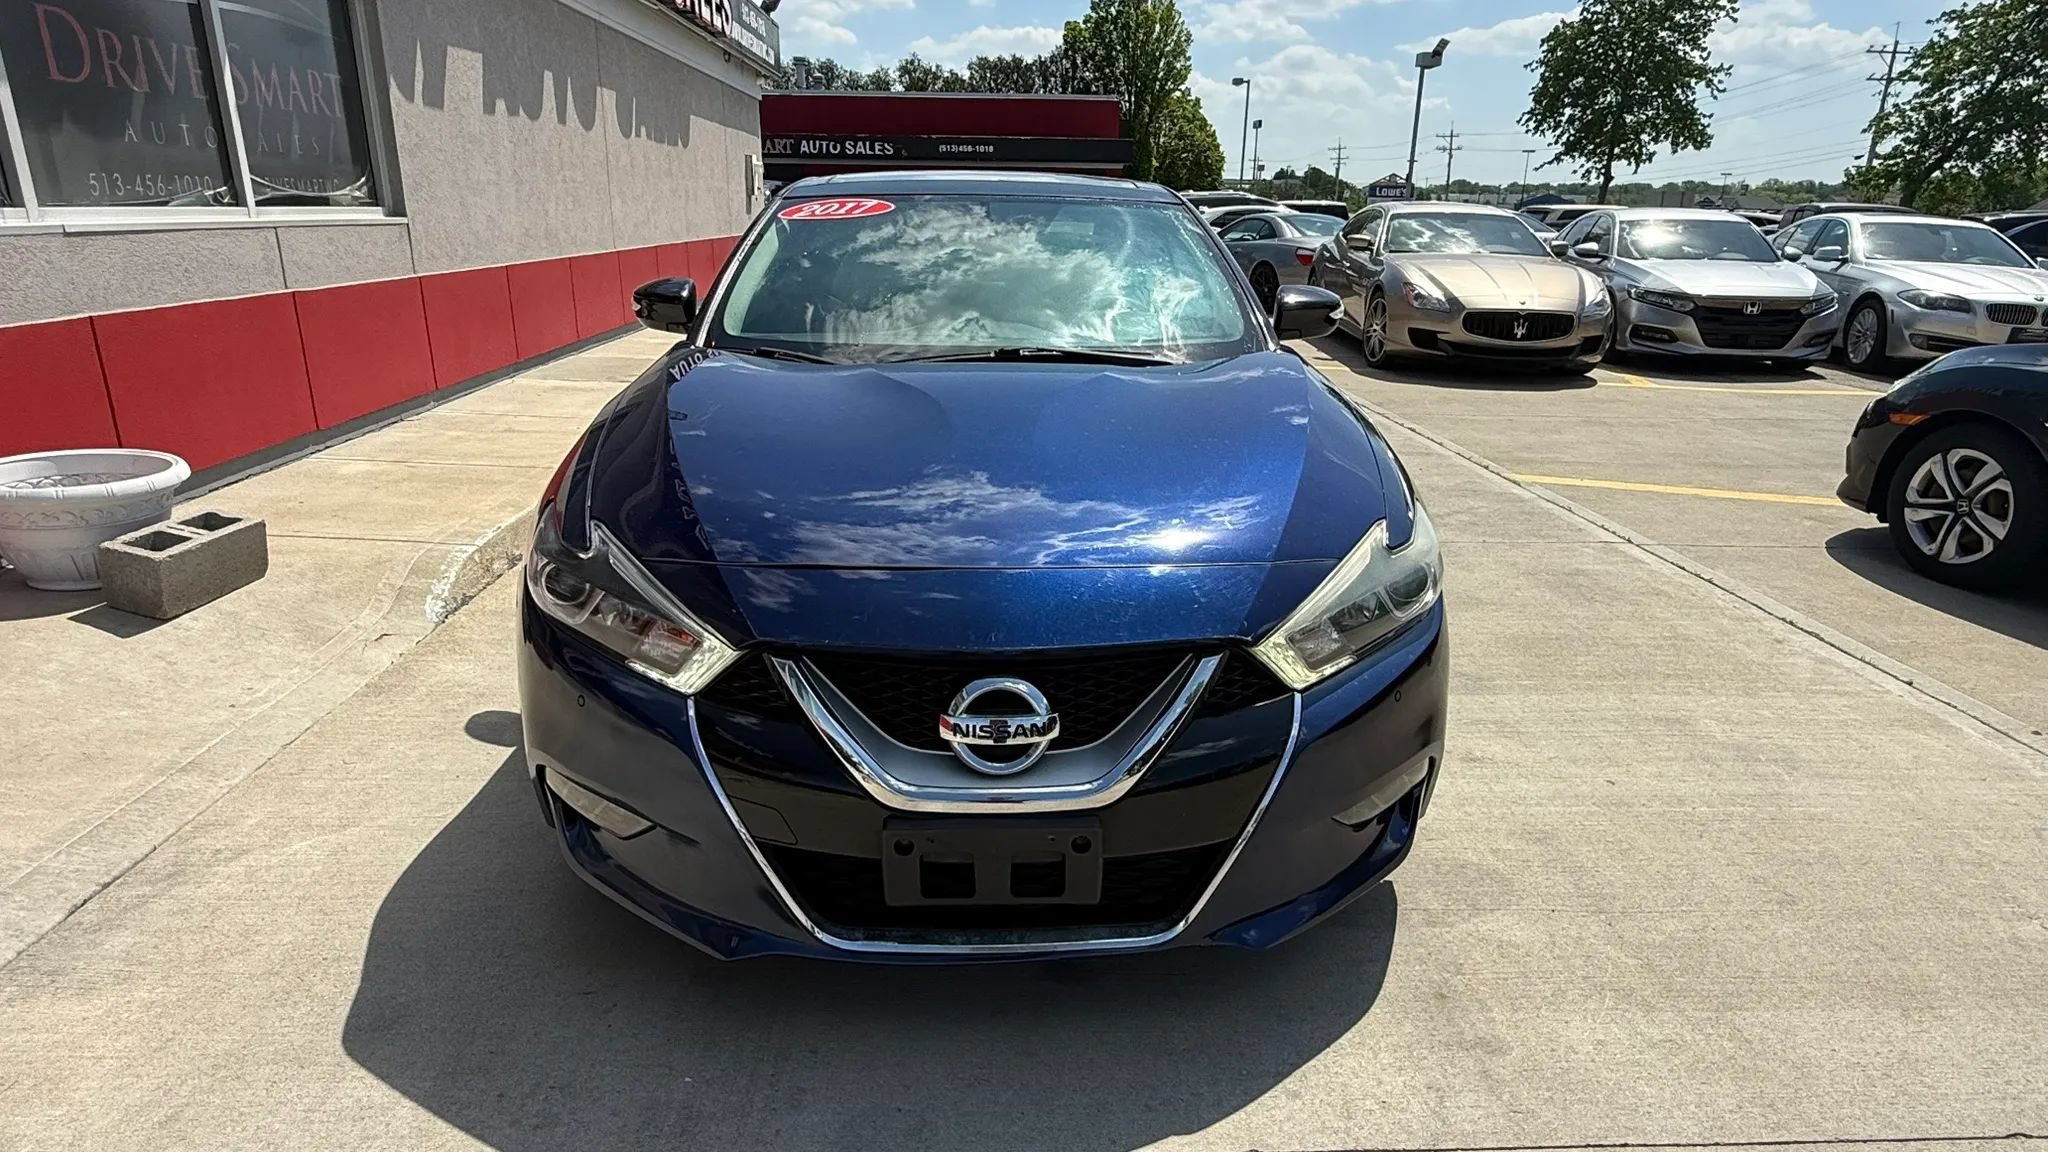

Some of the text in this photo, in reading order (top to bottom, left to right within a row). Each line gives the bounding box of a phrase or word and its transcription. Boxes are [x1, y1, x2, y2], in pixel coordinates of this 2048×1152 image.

[33, 2, 341, 118] DRIVE SMART
[125, 119, 320, 156] AUTO ALES
[800, 140, 840, 154] AUTO
[845, 141, 893, 155] SALES
[88, 172, 213, 197] 513-456-1010
[792, 200, 878, 218] 2017
[951, 722, 1050, 740] NISSAN
